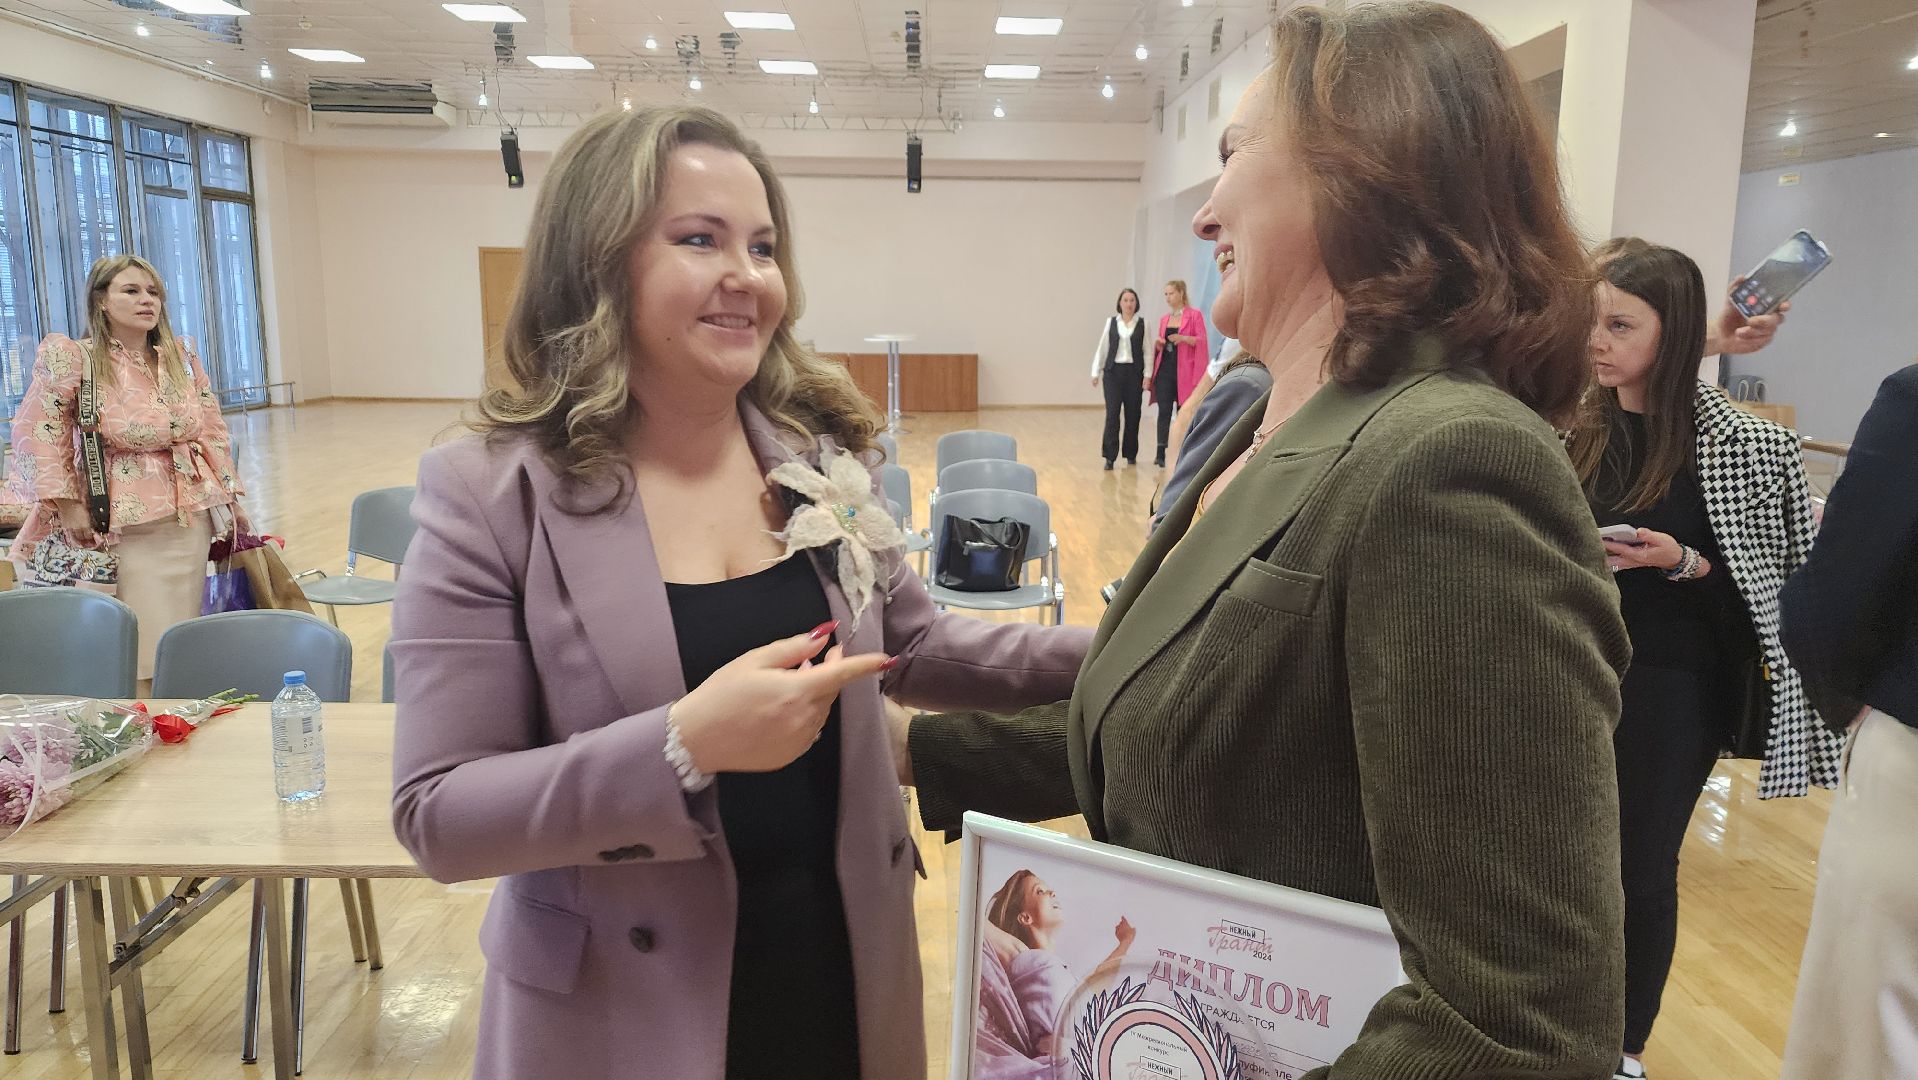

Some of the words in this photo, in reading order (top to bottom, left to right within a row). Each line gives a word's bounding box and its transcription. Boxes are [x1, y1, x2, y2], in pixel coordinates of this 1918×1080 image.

[1229, 925, 1256, 939] НЕЖНЫЙ
[1252, 950, 1272, 963] 2024
[1147, 948, 1332, 1028] ДИПЛОМ
